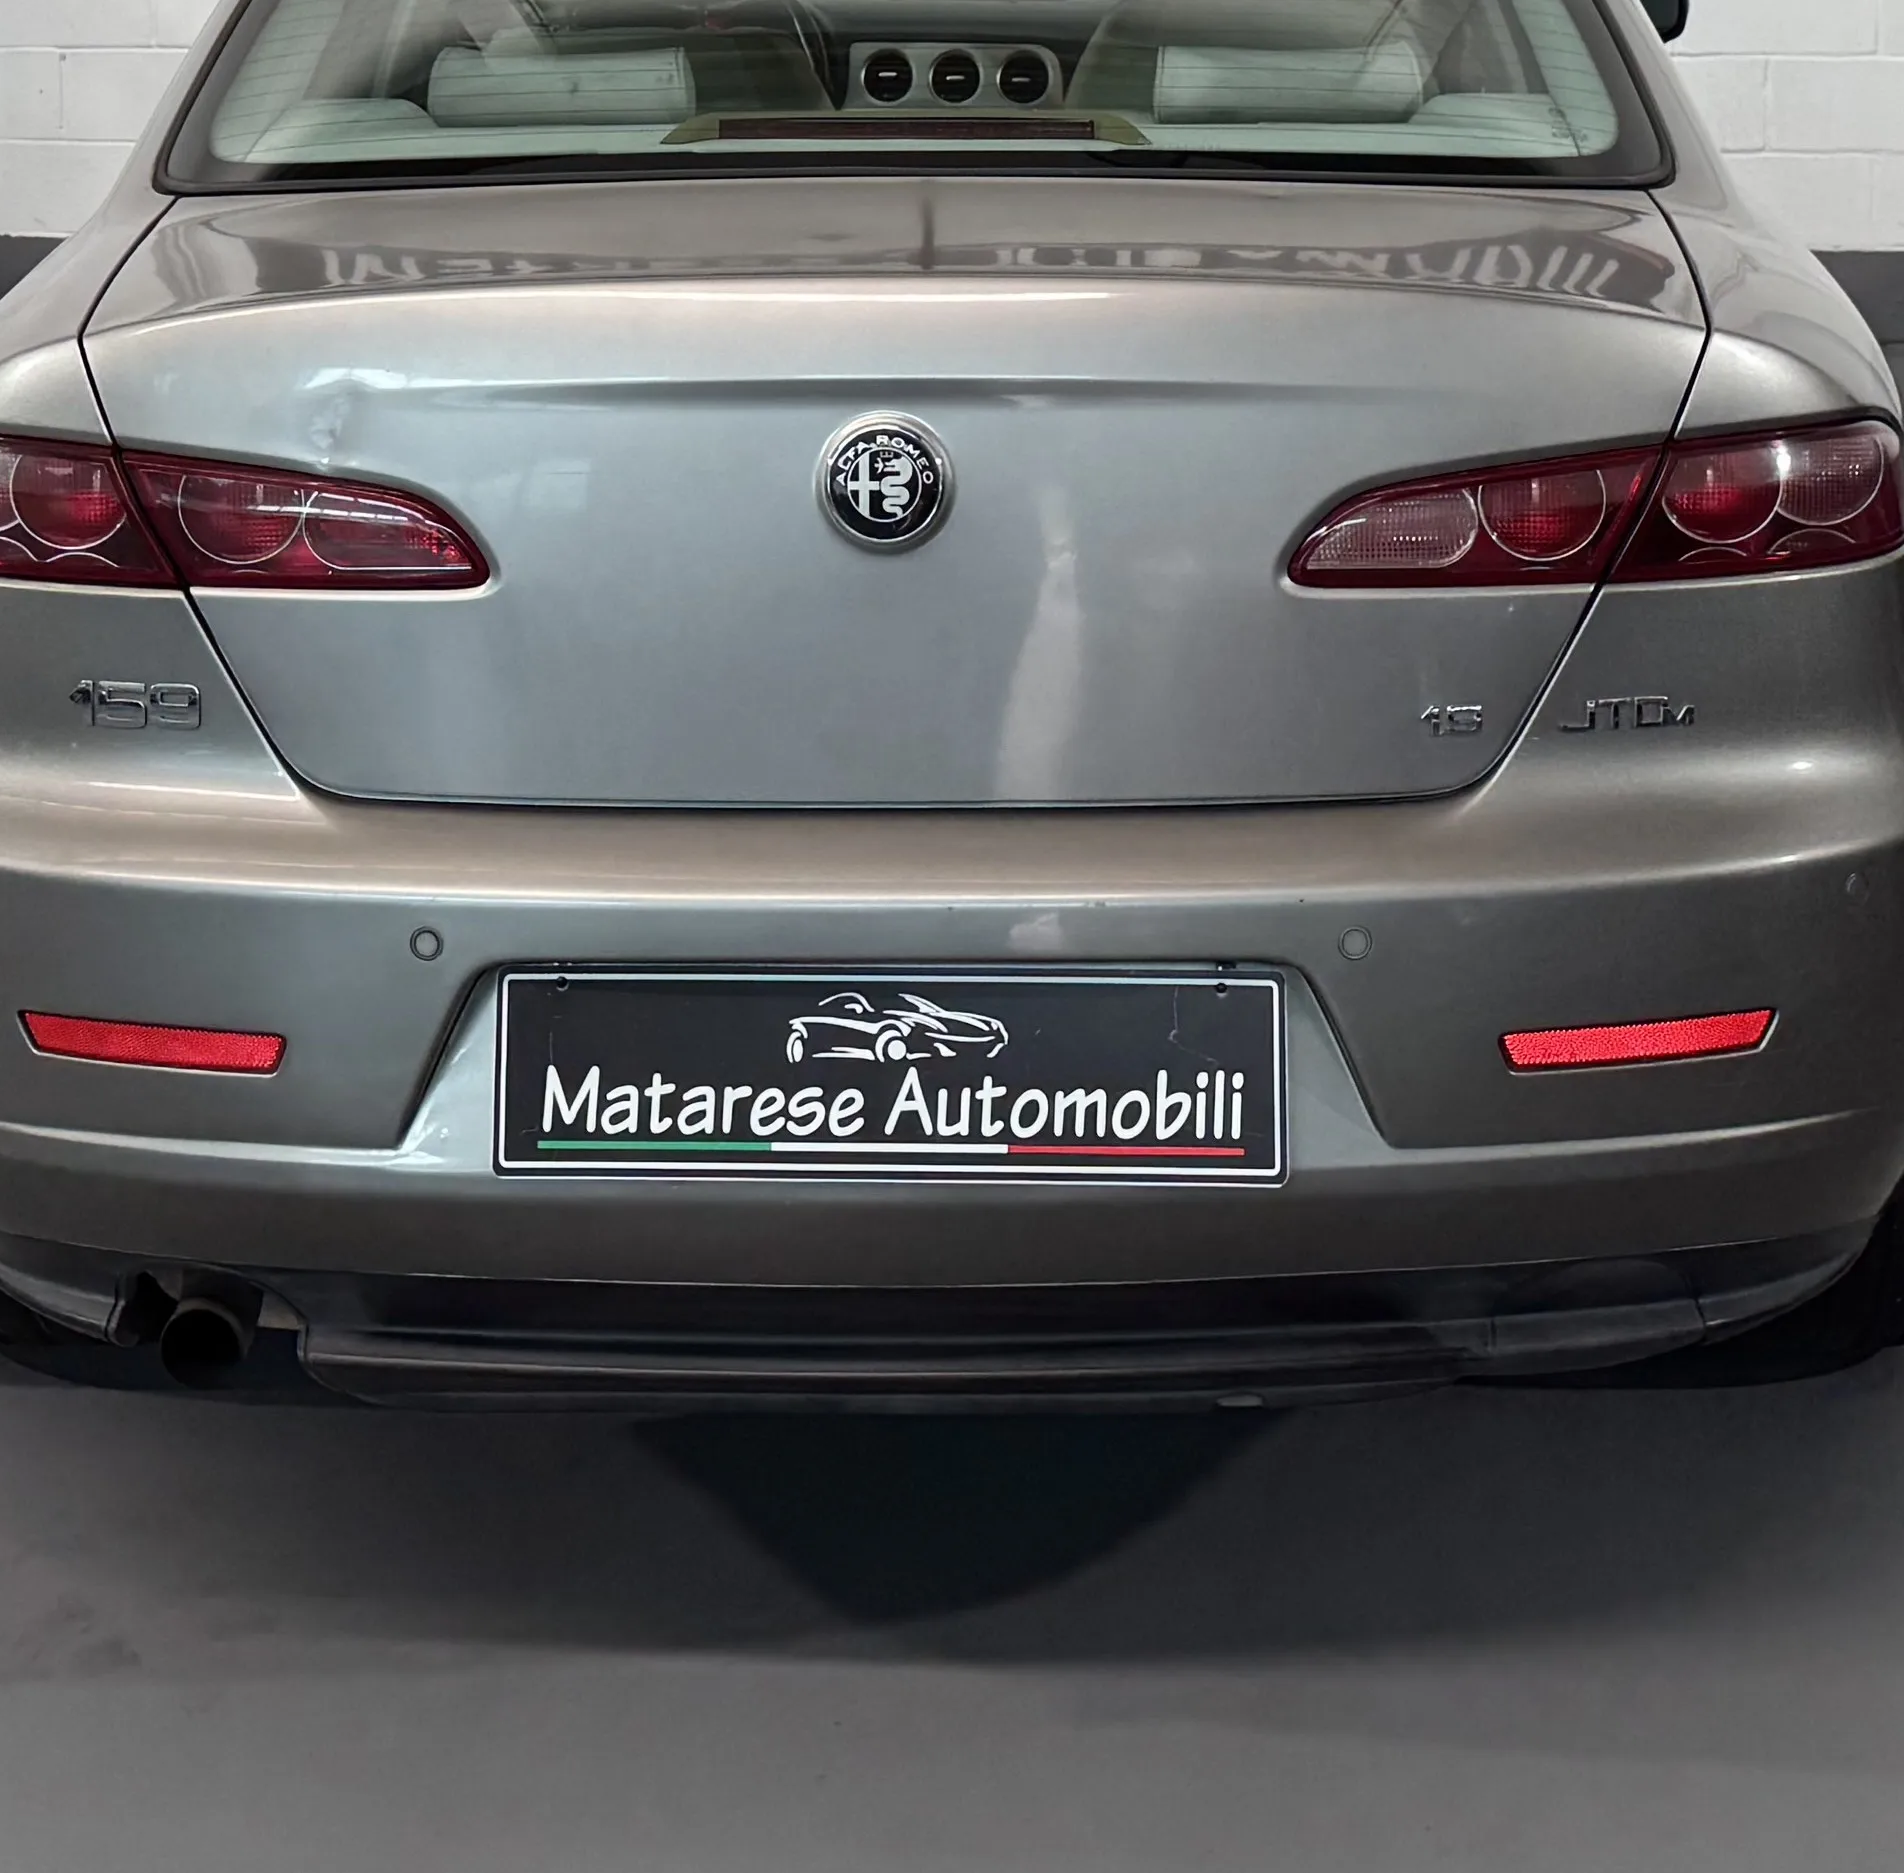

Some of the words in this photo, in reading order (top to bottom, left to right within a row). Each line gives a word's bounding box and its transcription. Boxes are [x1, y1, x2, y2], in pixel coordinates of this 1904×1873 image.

[835, 441, 874, 486] ALFA
[875, 434, 934, 484] ROMEO
[69, 679, 202, 729] 159
[542, 1064, 865, 1137] Matarese
[884, 1067, 1245, 1141] Automobili
